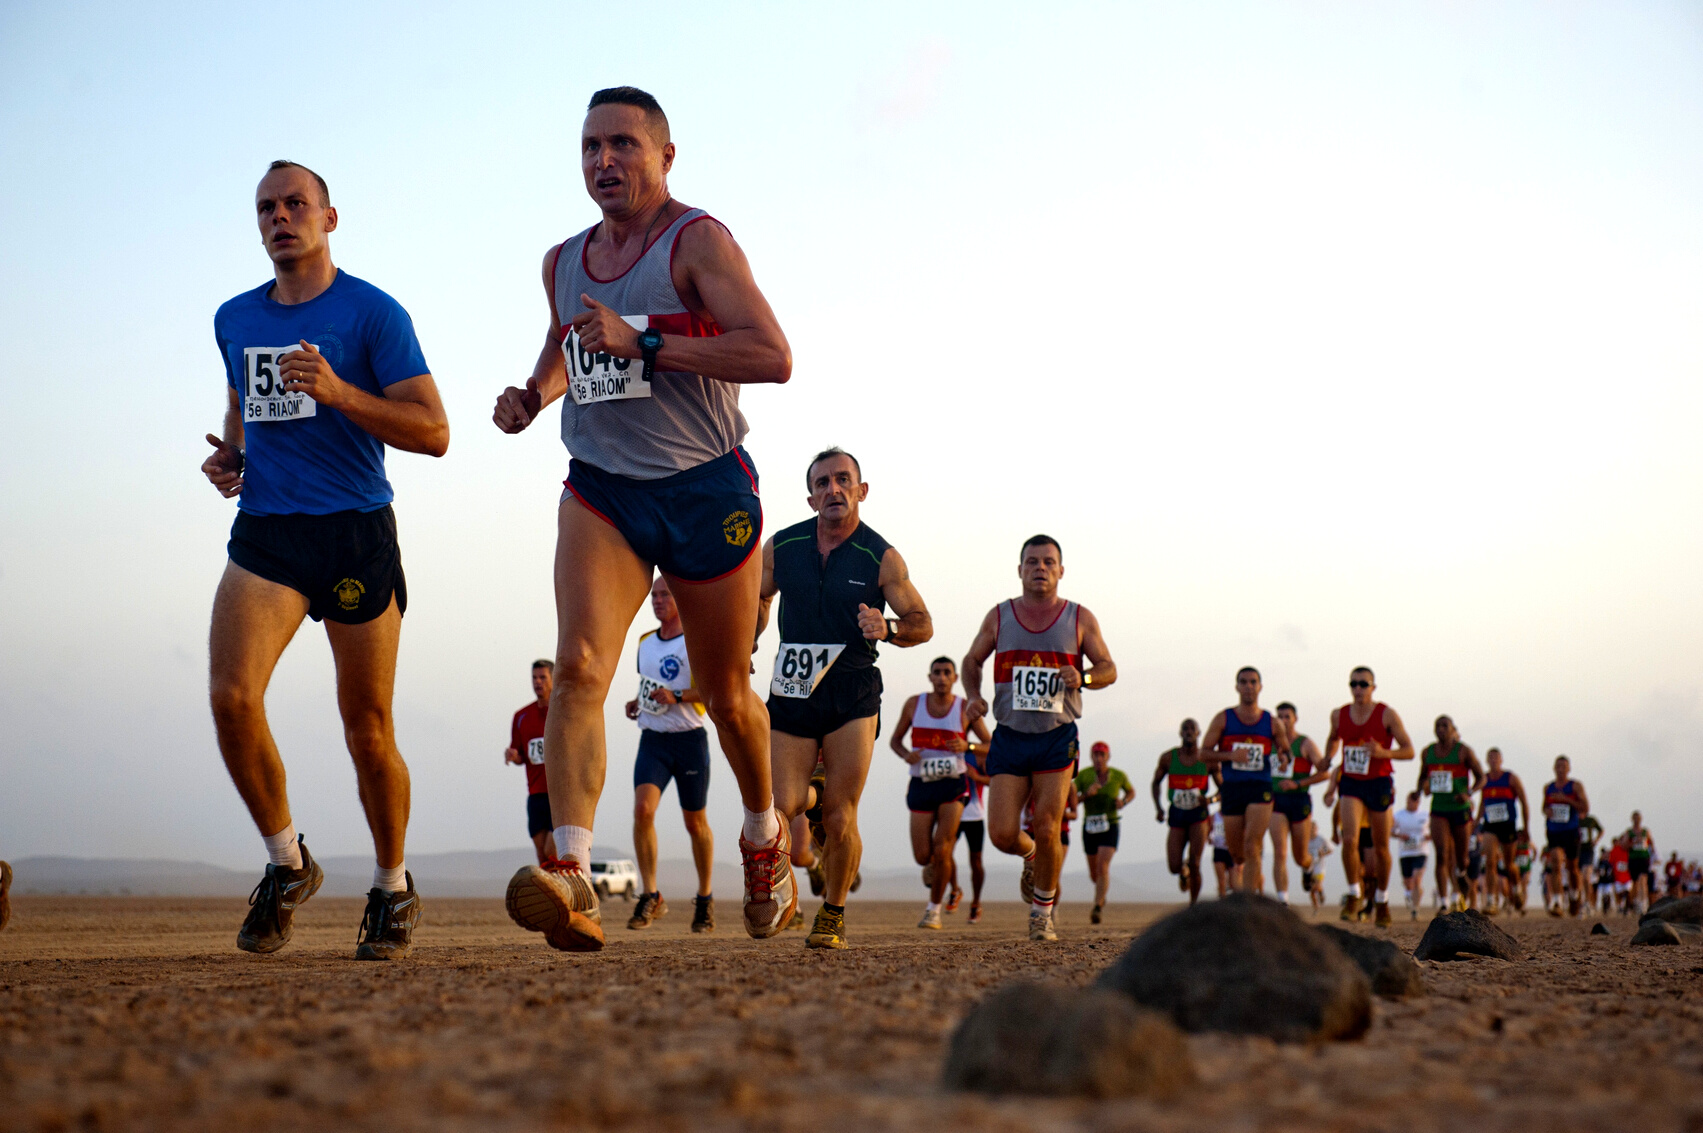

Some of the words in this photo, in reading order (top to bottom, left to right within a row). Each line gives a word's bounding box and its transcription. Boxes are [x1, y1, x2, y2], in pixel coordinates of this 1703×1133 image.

[781, 648, 829, 680] 691
[640, 678, 665, 701] 162
[1014, 670, 1060, 697] 1650
[923, 759, 952, 777] 1159
